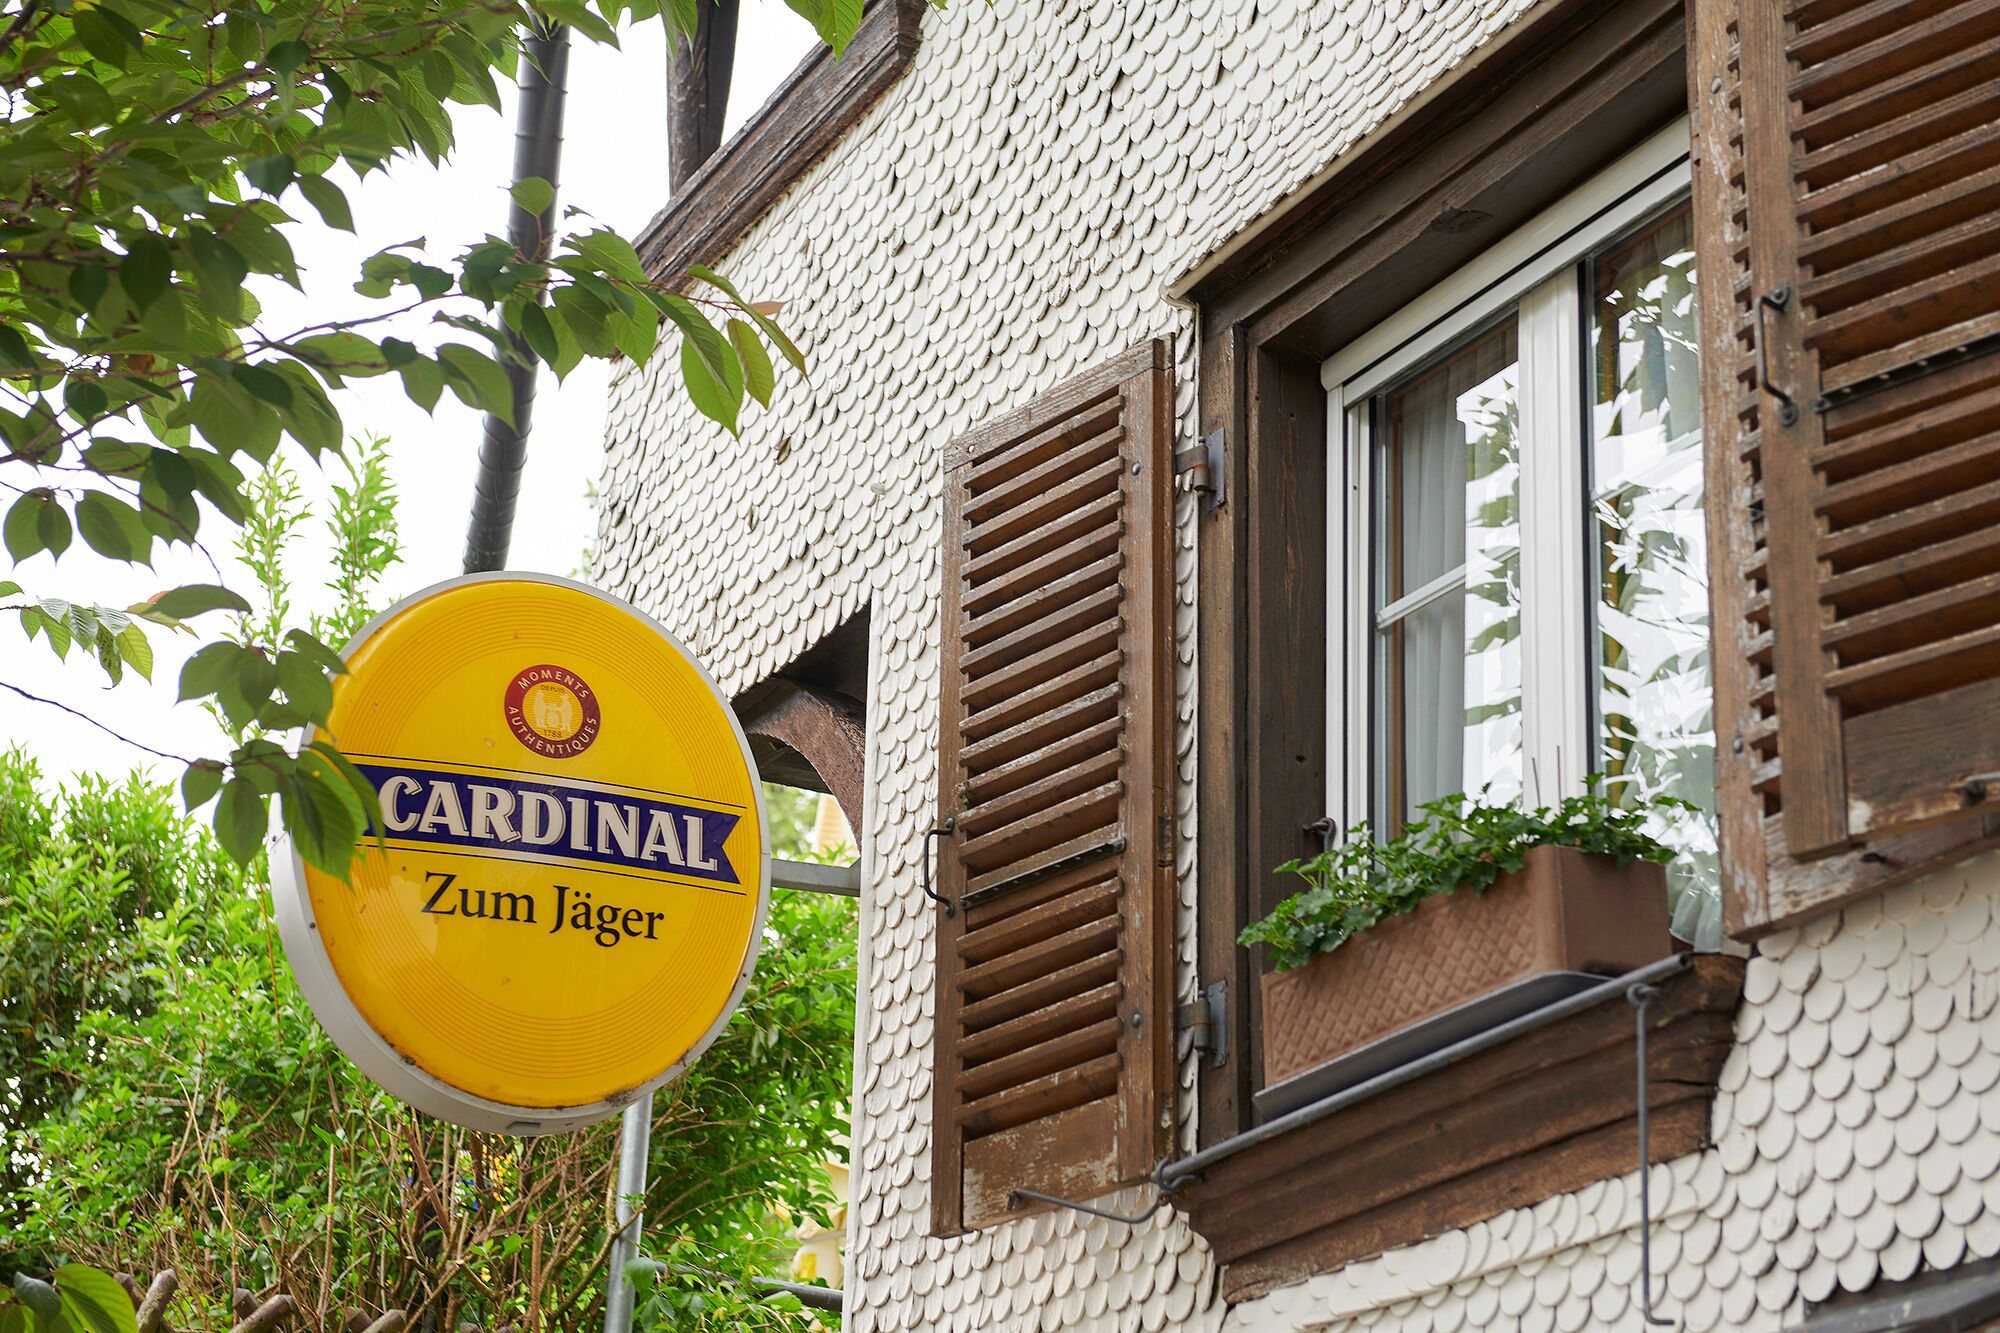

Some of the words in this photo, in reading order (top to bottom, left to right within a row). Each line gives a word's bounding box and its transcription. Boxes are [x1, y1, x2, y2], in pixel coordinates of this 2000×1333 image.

[517, 669, 590, 698] MOMENTS
[508, 706, 597, 754] AUTHENTIQUES
[378, 775, 719, 872] CARDINAL
[420, 870, 537, 924] Zum
[549, 884, 665, 948] Jäger
